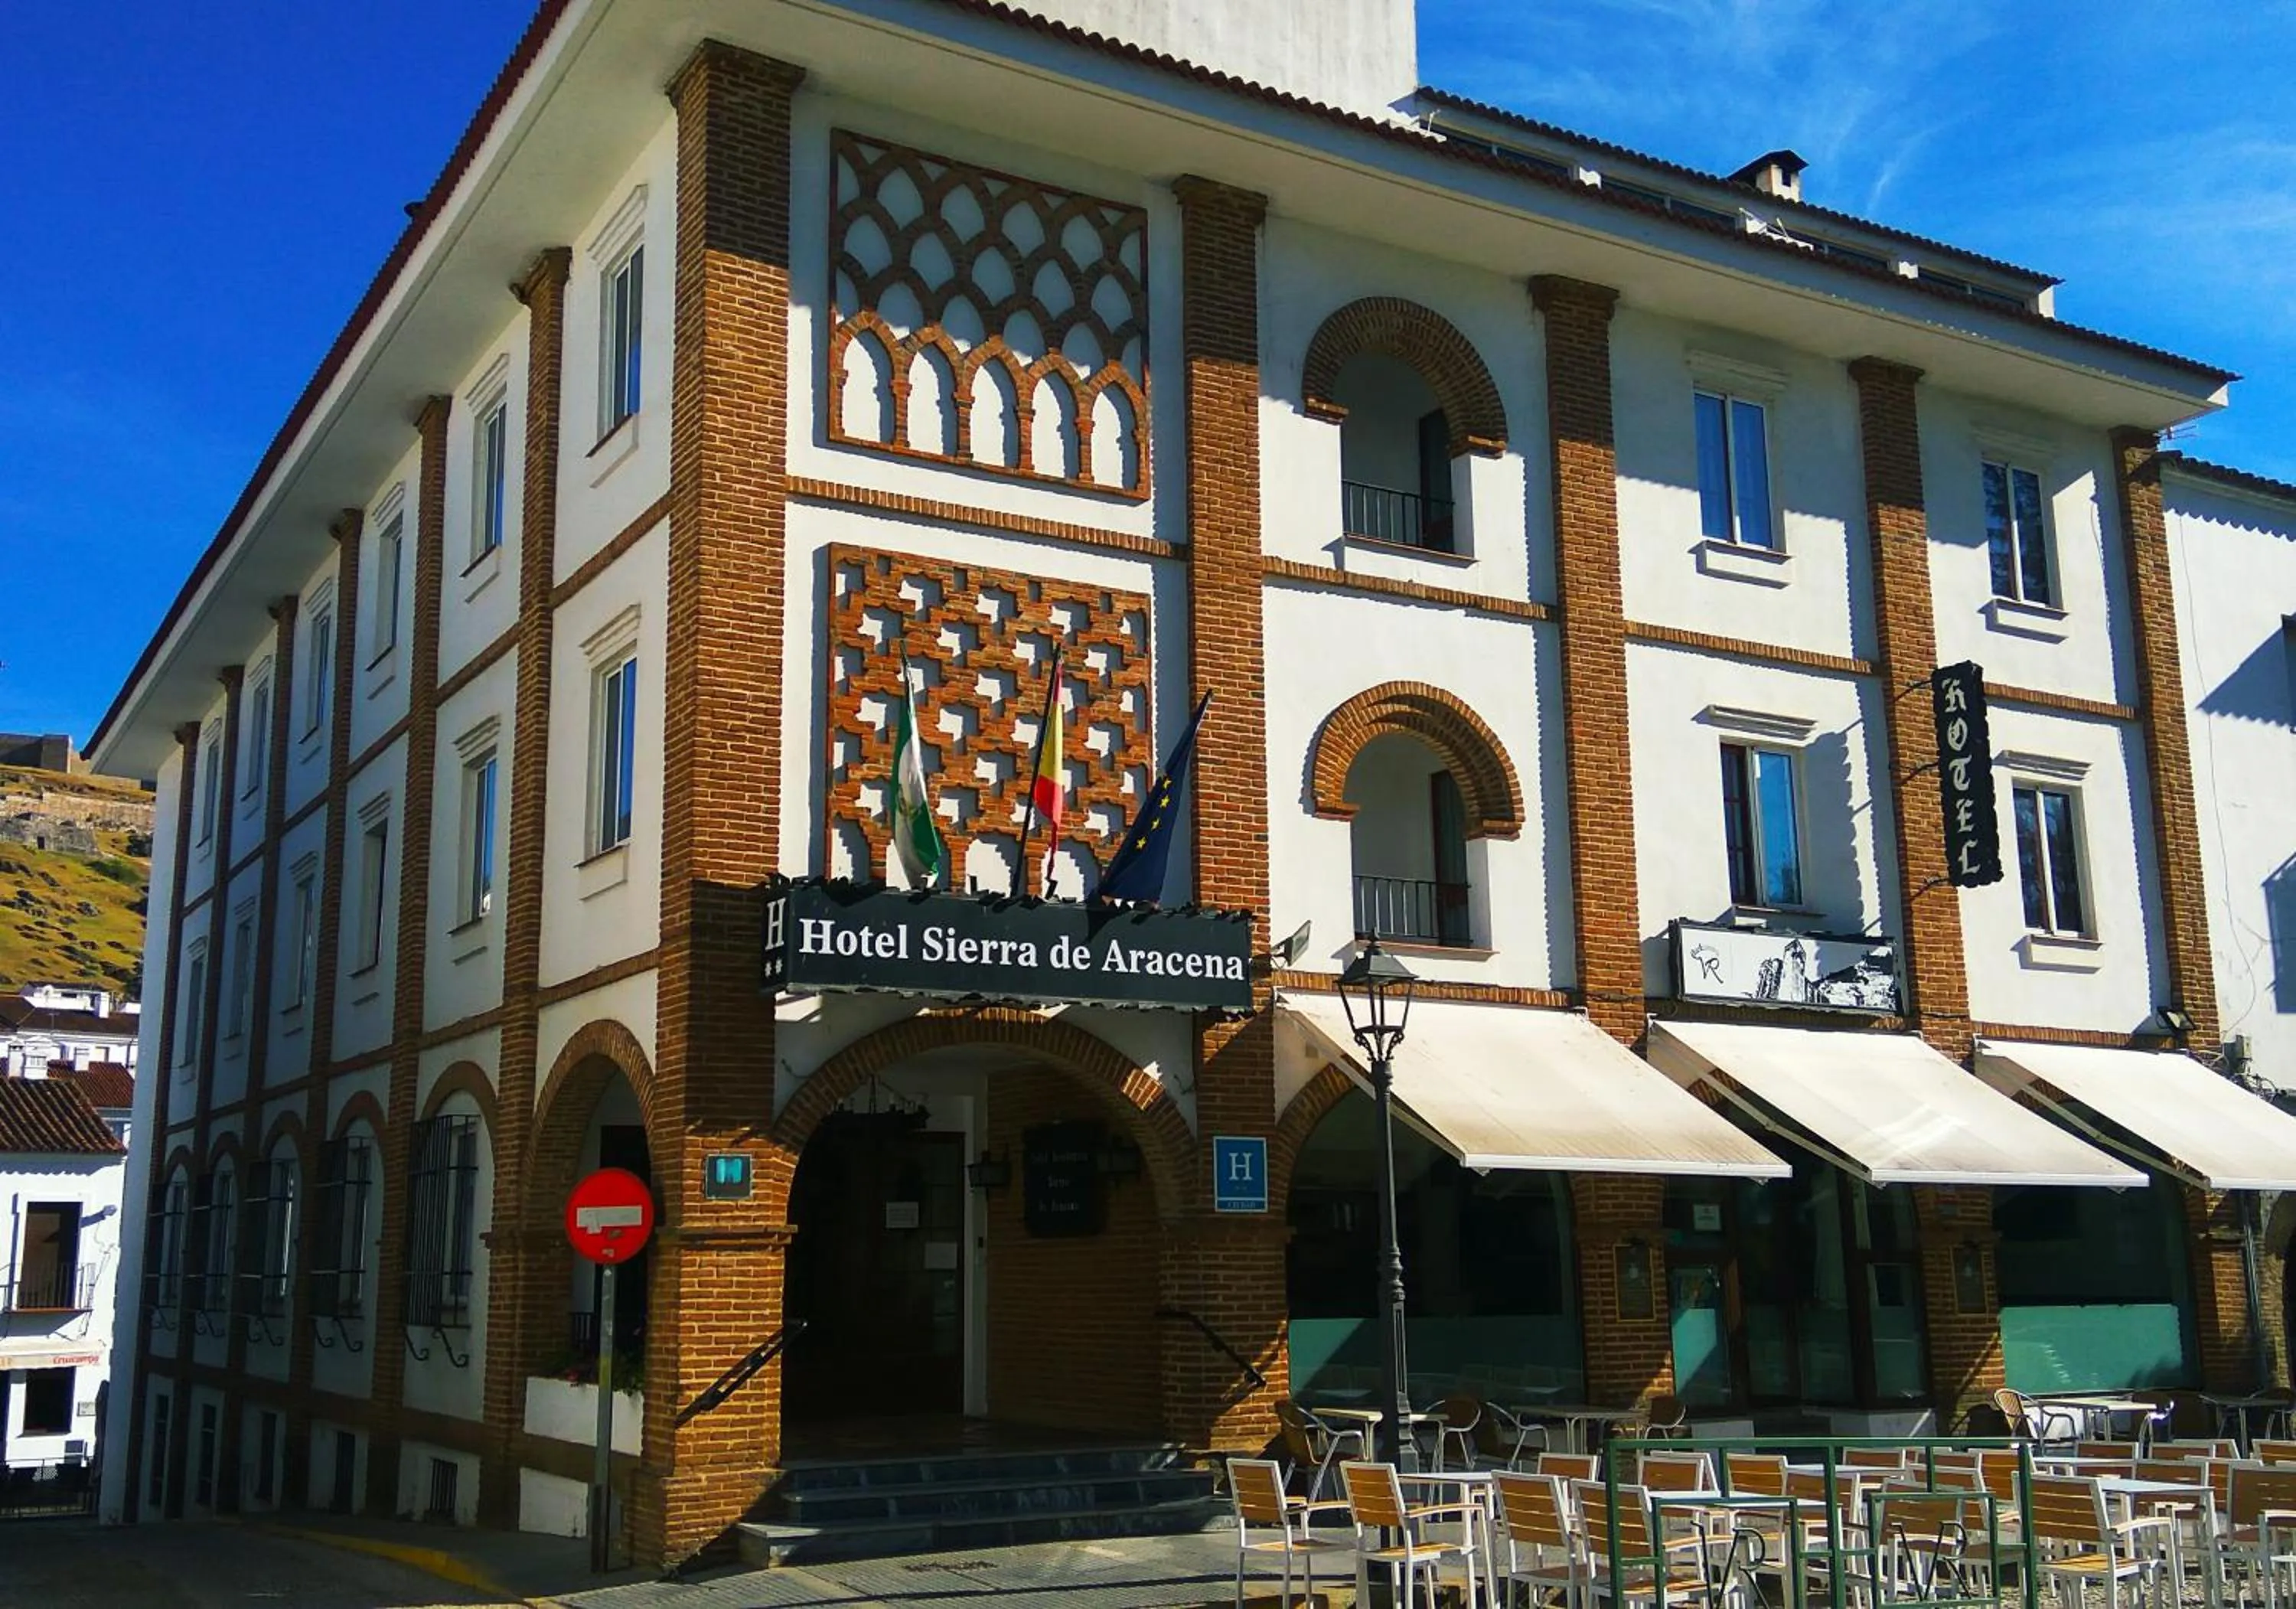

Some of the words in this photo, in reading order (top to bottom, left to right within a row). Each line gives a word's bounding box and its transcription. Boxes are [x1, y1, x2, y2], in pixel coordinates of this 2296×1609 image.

[1942, 678, 1980, 875] HOTEL
[765, 897, 786, 950] H
[798, 918, 908, 959] Hotel
[922, 926, 1038, 967] Sierra
[1049, 935, 1091, 970] de
[1101, 939, 1244, 981] Aracena
[1228, 1152, 1253, 1180] H
